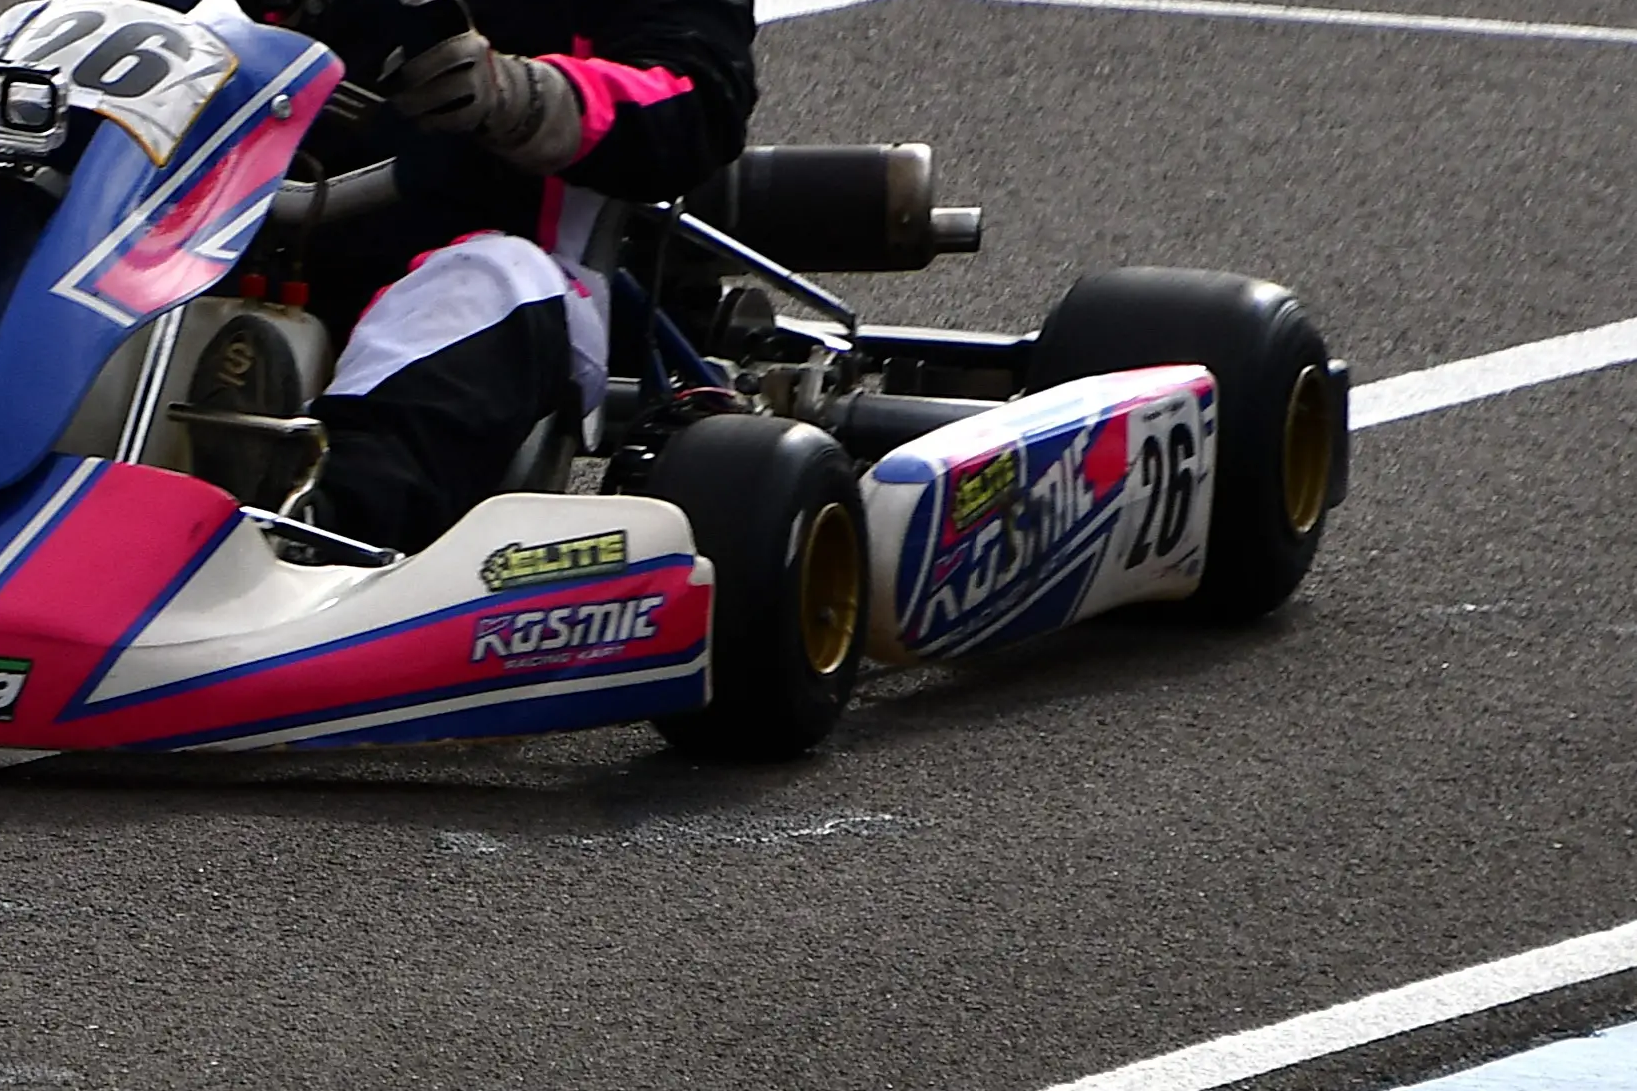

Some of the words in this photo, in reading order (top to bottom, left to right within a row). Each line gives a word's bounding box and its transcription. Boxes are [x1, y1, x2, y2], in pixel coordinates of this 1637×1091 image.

[24, 10, 194, 98] 26
[1125, 422, 1195, 570] 26
[471, 595, 664, 661] KOSMIC
